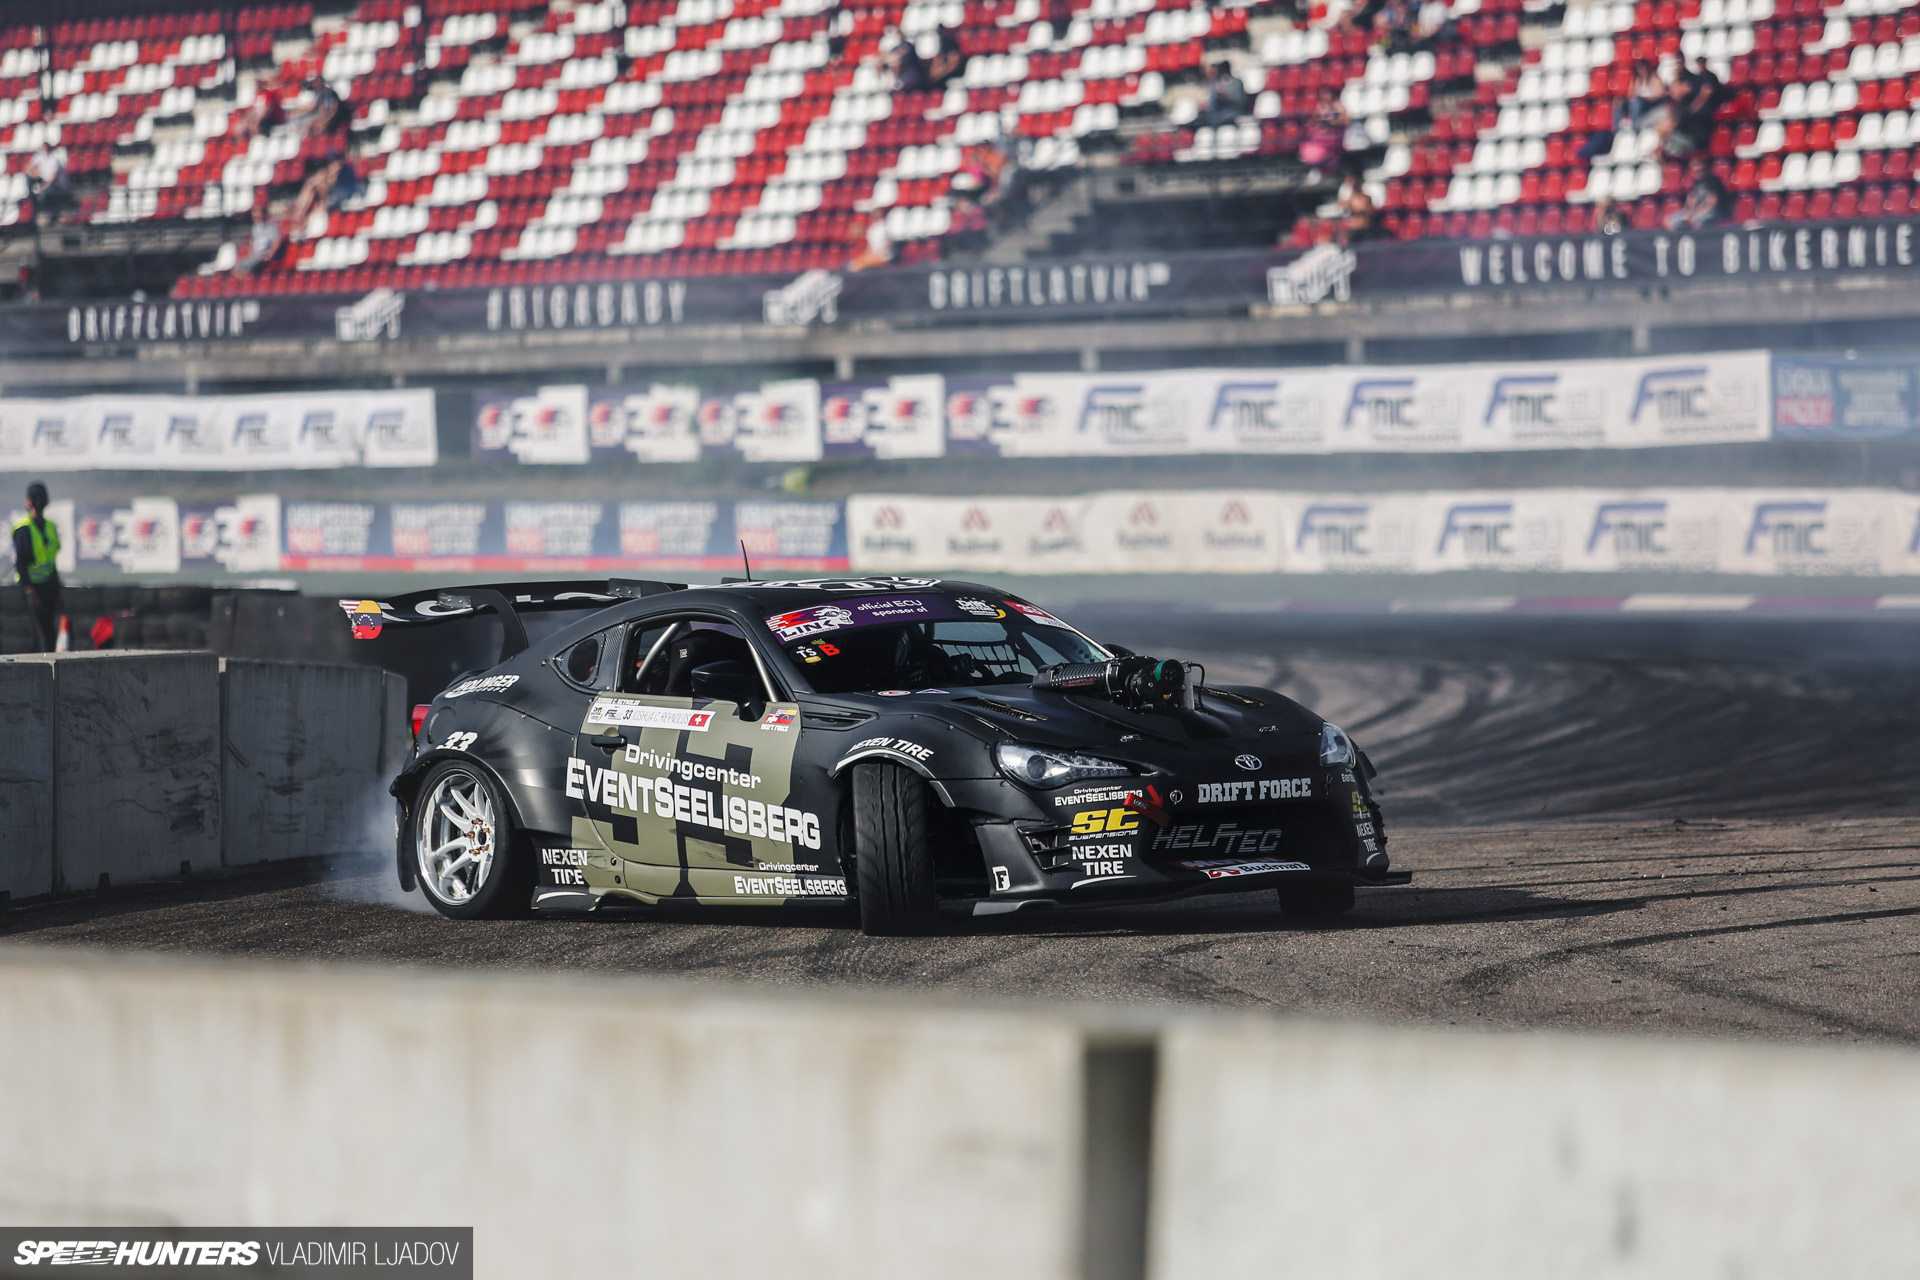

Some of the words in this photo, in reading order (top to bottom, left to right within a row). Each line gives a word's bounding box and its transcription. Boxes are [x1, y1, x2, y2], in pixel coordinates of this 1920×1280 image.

[1460, 238, 1628, 286] WELCOME
[1653, 235, 1696, 278] TO
[857, 600, 893, 611] official
[872, 608, 914, 616] sponsor
[779, 619, 837, 638] LINK
[445, 731, 478, 752] 33
[892, 739, 935, 761] TIRE
[624, 743, 762, 789] Drivingcenter
[1073, 785, 1123, 794] Drivingcenter
[1197, 780, 1255, 804] DRIFT
[1258, 778, 1312, 800] FORCE
[1071, 843, 1133, 861] NEXEN
[1363, 837, 1378, 852] TIRE
[541, 848, 588, 866] NEXEN
[758, 861, 819, 873] Drivingcenter
[1082, 860, 1125, 876] TIRE
